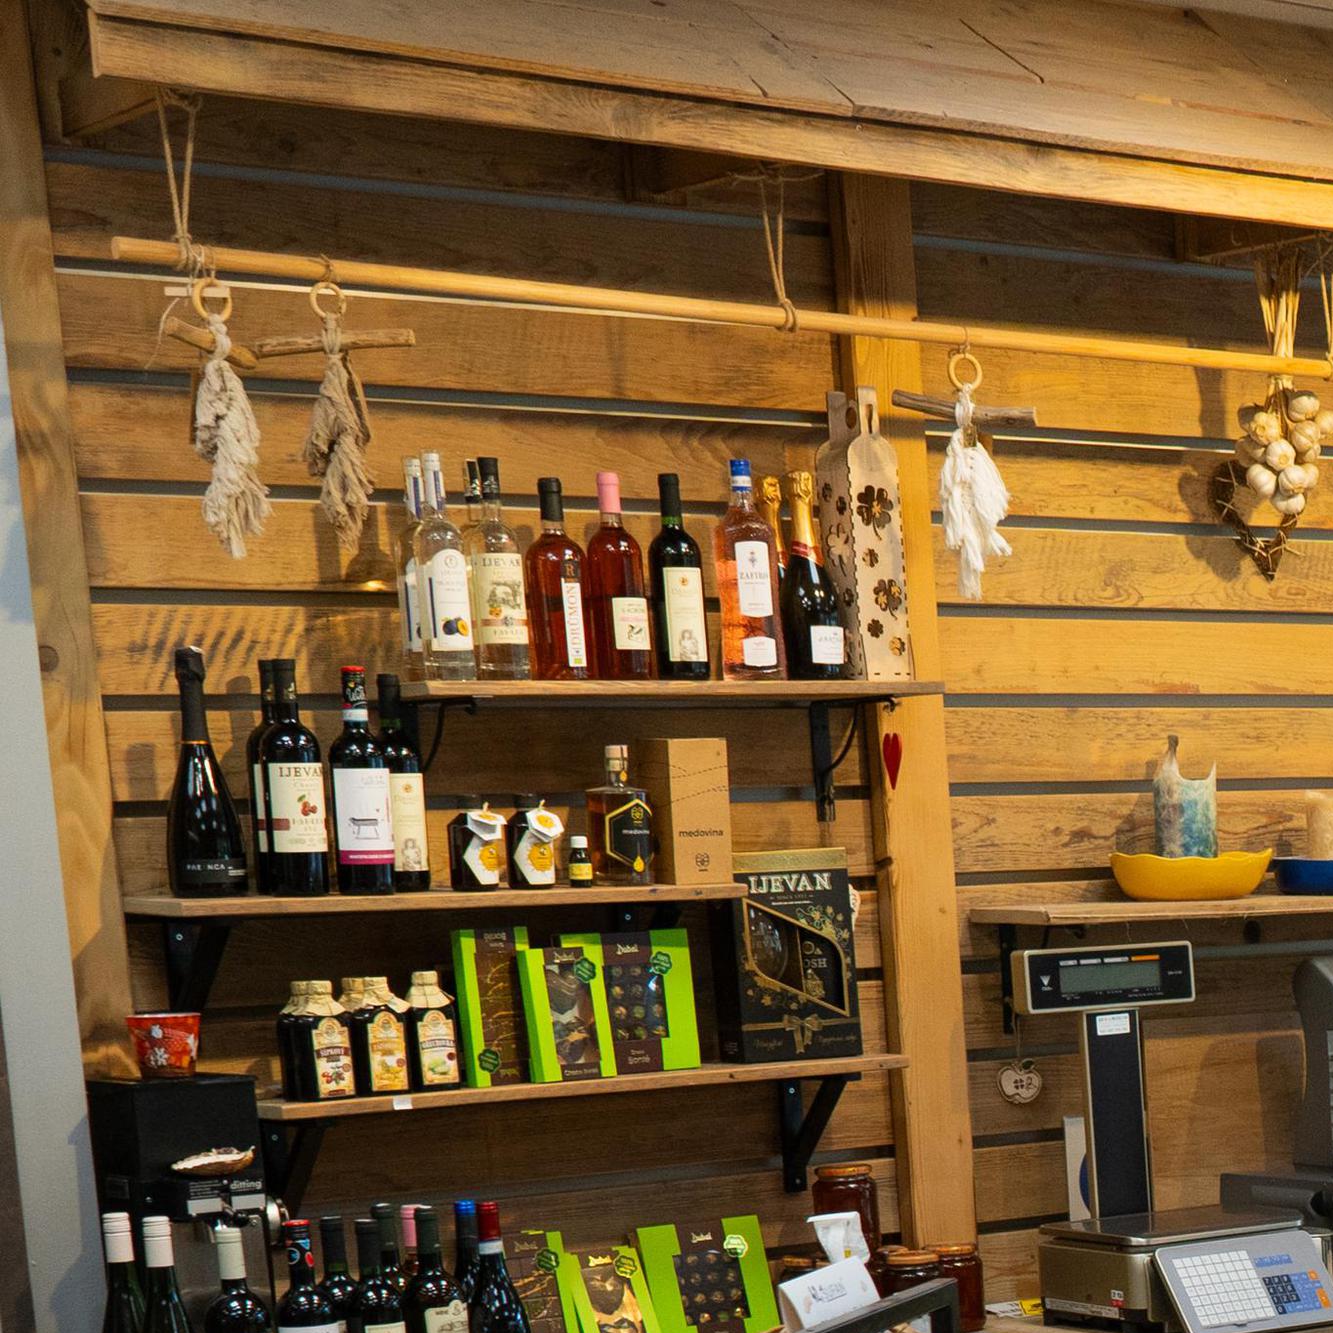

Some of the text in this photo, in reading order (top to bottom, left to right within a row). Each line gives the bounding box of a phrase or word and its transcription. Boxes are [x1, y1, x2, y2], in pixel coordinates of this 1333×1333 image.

[678, 827, 724, 838] medovina
[748, 871, 833, 895] IJEVAN
[229, 1179, 263, 1191] ditting
